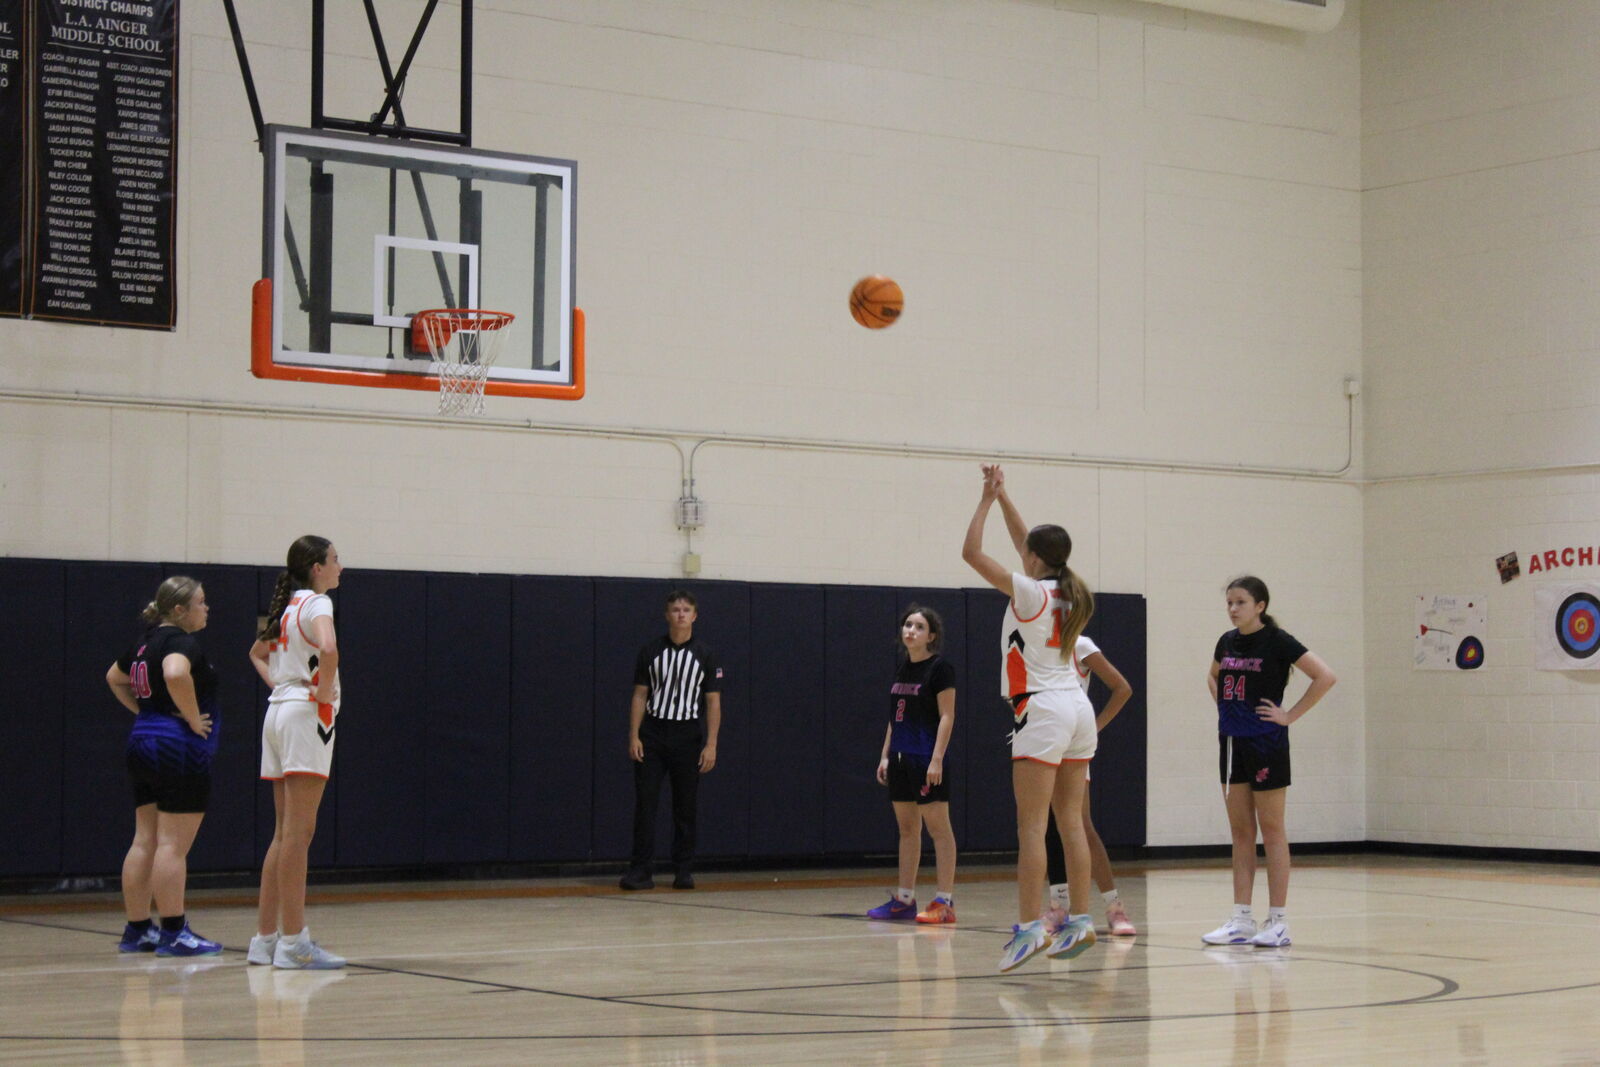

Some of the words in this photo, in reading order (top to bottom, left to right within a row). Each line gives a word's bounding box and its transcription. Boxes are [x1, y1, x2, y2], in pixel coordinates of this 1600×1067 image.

[111, 1, 154, 17] CHAMPS
[65, 13, 92, 27] L.A.
[96, 17, 148, 36] AINGER
[52, 26, 105, 45] MIDDLE
[108, 34, 163, 53] SCHOOL
[42, 53, 65, 62] COACH
[65, 56, 78, 64] JEFF
[42, 77, 72, 86] CAMERON
[136, 89, 161, 98] GALLANT
[44, 101, 74, 110] JACKSON
[116, 98, 134, 107] CALEB
[135, 101, 162, 110] GARLAND
[48, 136, 68, 145] LUCAS
[50, 147, 75, 157] TUCKER
[75, 150, 93, 159] CERA
[54, 160, 67, 168] BEN
[48, 171, 66, 180] RILEY
[112, 167, 135, 176] HUNTER
[135, 169, 164, 180] MCCLOUD
[50, 183, 67, 192] NOAH
[68, 185, 91, 195] COOKE
[49, 195, 65, 203] JACK
[65, 196, 91, 206] CREECH
[77, 232, 93, 241] DIAZ
[114, 248, 136, 257] BLAINE
[111, 259, 139, 269] DANIELLE
[137, 296, 154, 305] WEBB
[1529, 546, 1600, 574] ARCH
[1223, 674, 1246, 701] 24
[895, 698, 906, 722] 2
